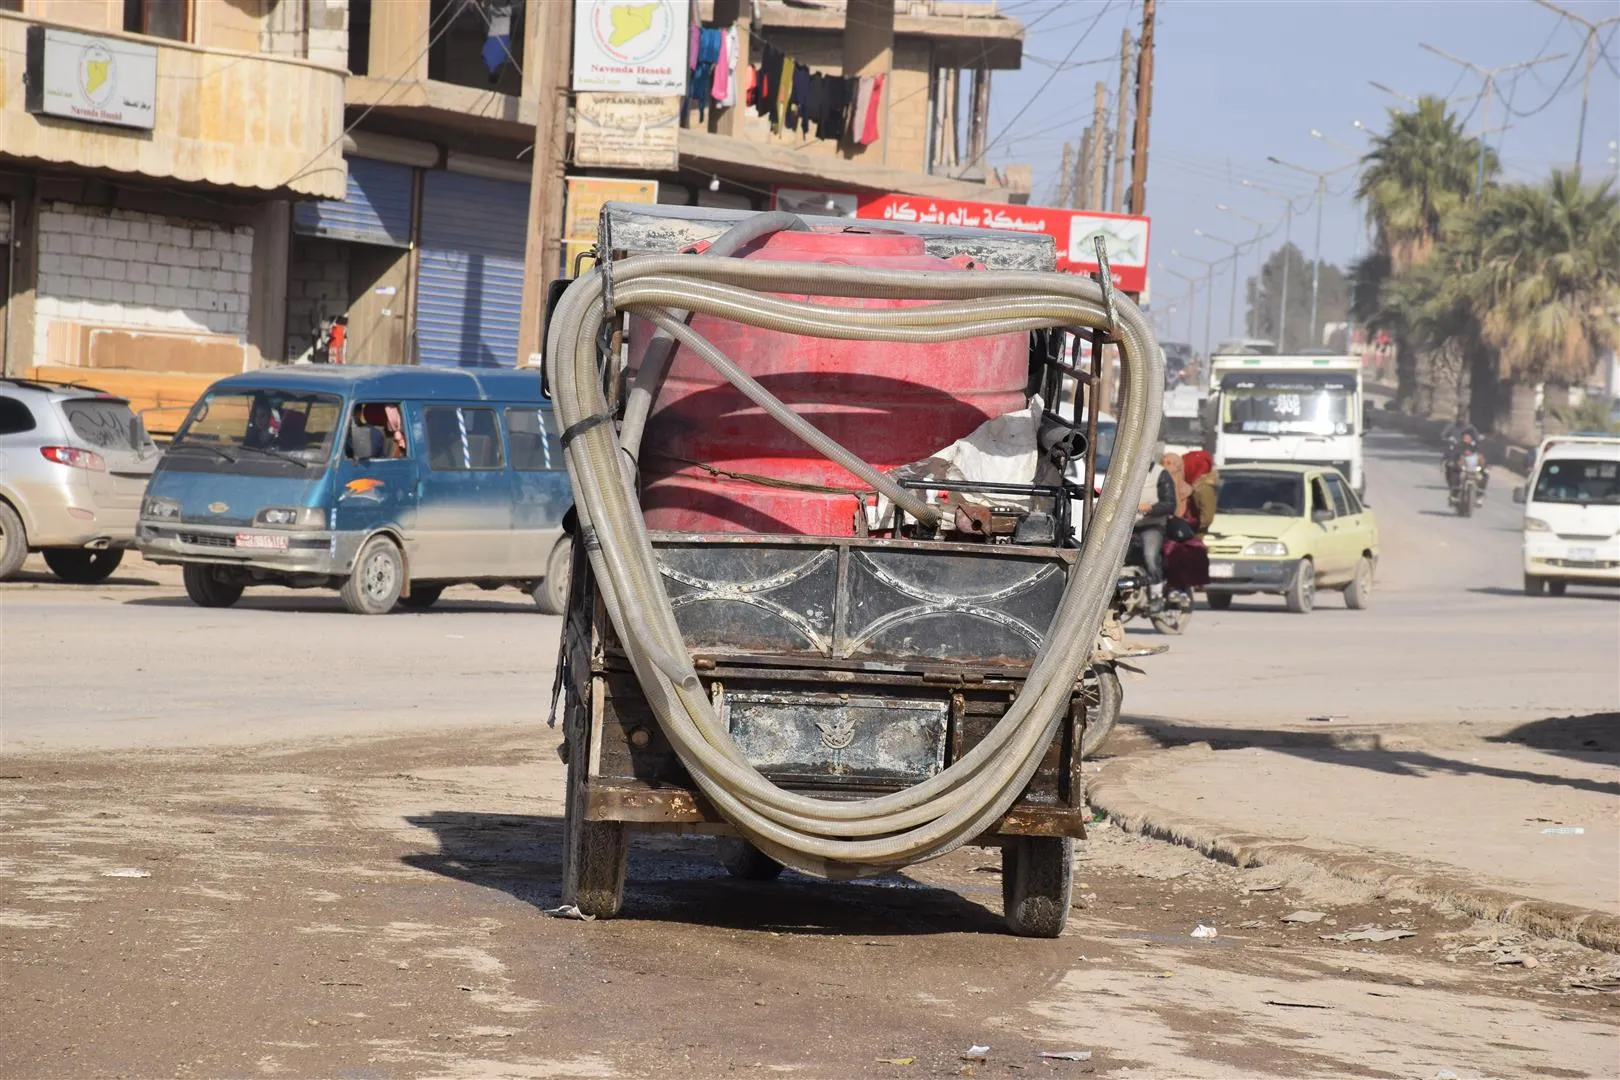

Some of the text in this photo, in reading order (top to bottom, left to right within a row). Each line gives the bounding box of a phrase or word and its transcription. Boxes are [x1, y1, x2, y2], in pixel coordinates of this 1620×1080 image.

[883, 202, 1046, 231] مسمكة سالم وشركاه
